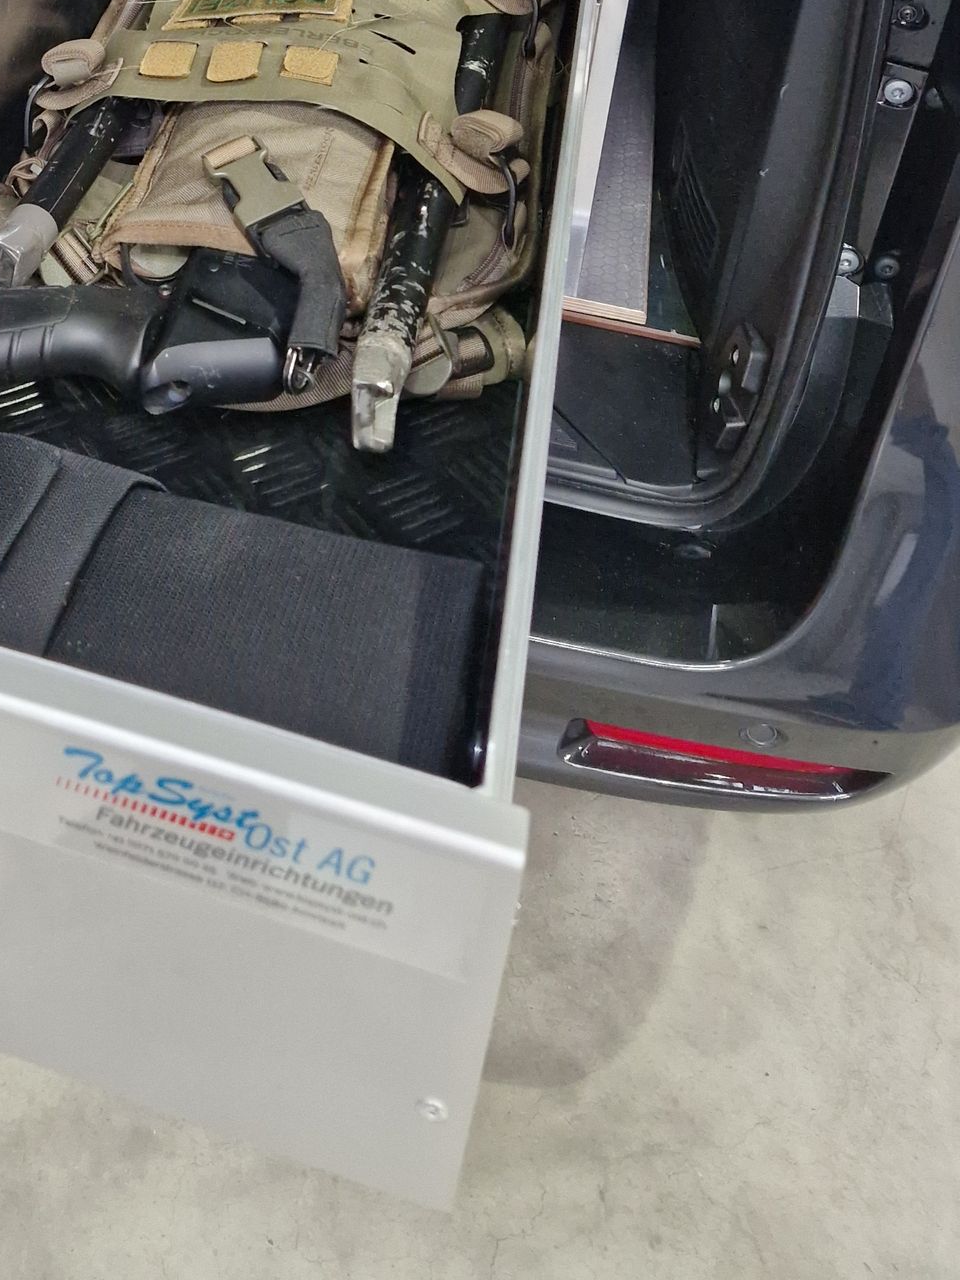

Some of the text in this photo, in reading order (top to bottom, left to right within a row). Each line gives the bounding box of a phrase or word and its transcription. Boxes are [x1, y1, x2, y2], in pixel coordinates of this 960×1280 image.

[64, 747, 259, 829] TopSyst
[244, 823, 309, 865] Ost
[316, 847, 376, 885] AG
[95, 805, 394, 915] Fahrzeugeinrichtungen
